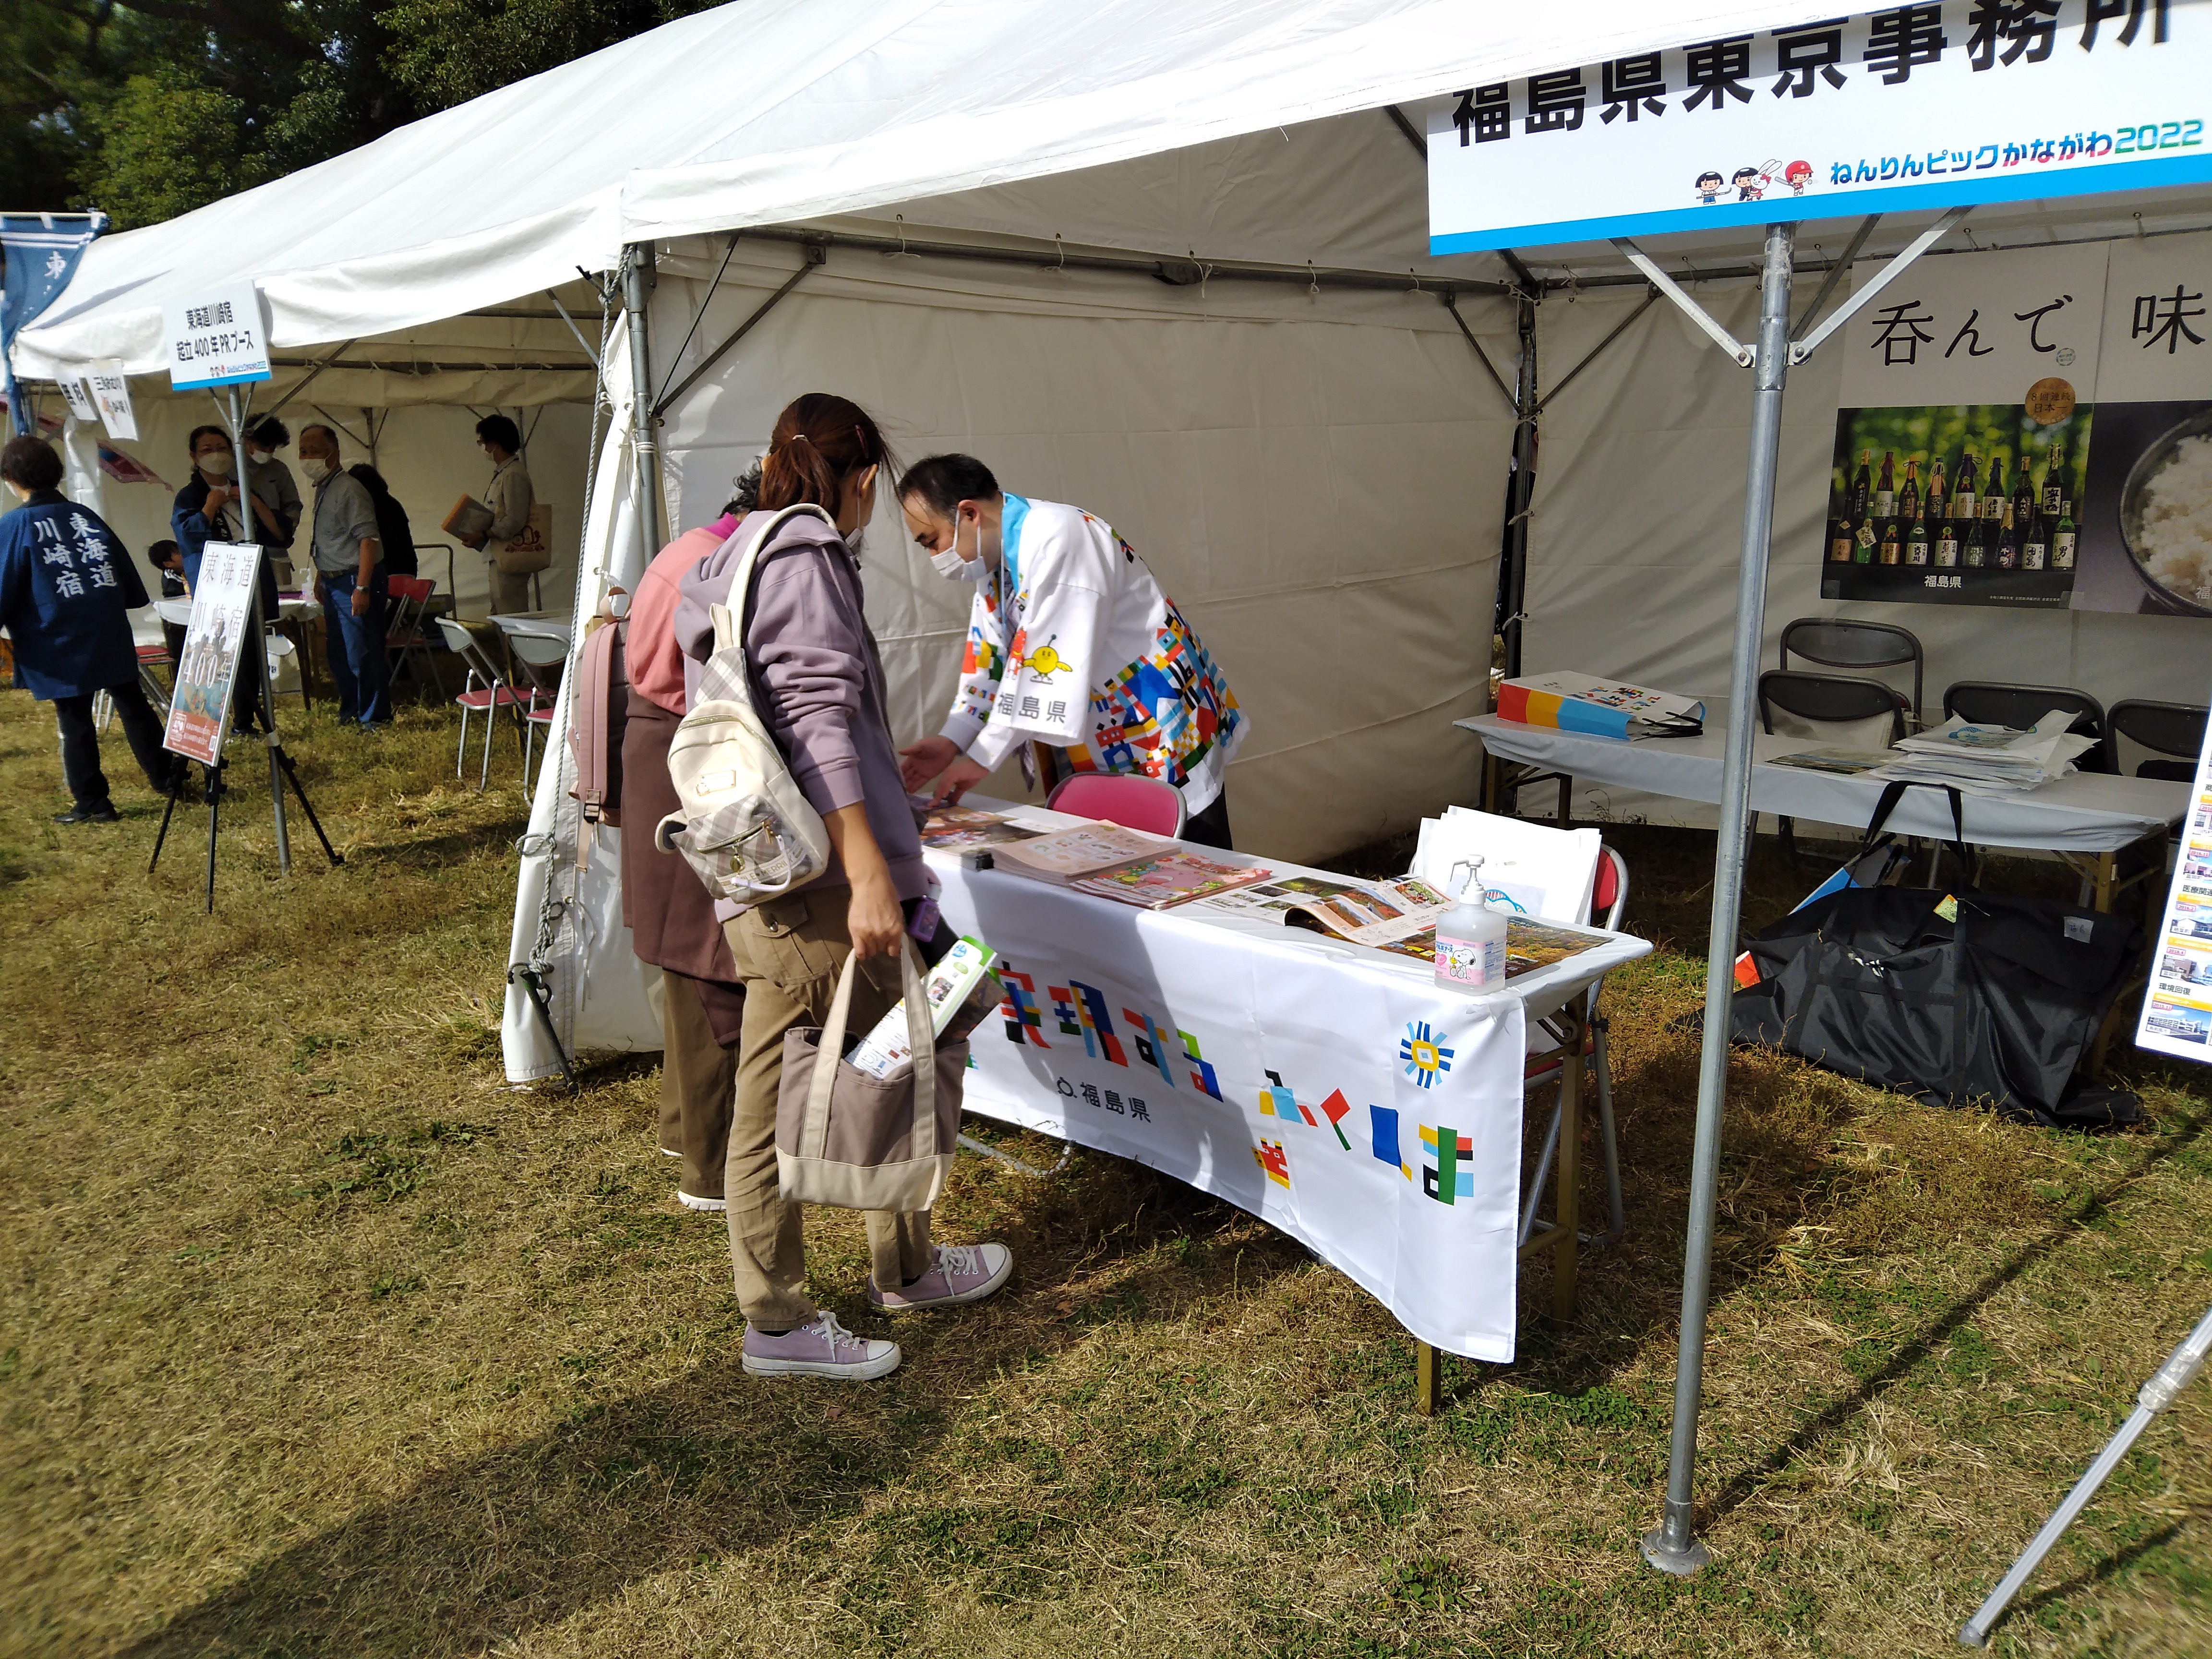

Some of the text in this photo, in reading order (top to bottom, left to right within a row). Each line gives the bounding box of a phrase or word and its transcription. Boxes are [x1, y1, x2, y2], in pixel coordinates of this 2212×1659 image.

[1871, 294, 2073, 366] 呑んで
[34, 517, 84, 598] 川崎宿
[69, 512, 118, 588] 東海道
[202, 552, 253, 587] 東海道
[1924, 575, 1962, 589] 福島県
[998, 693, 1066, 723] 福島県
[2158, 983, 2191, 996] 環境回復
[1080, 1082, 1152, 1124] 福島県
